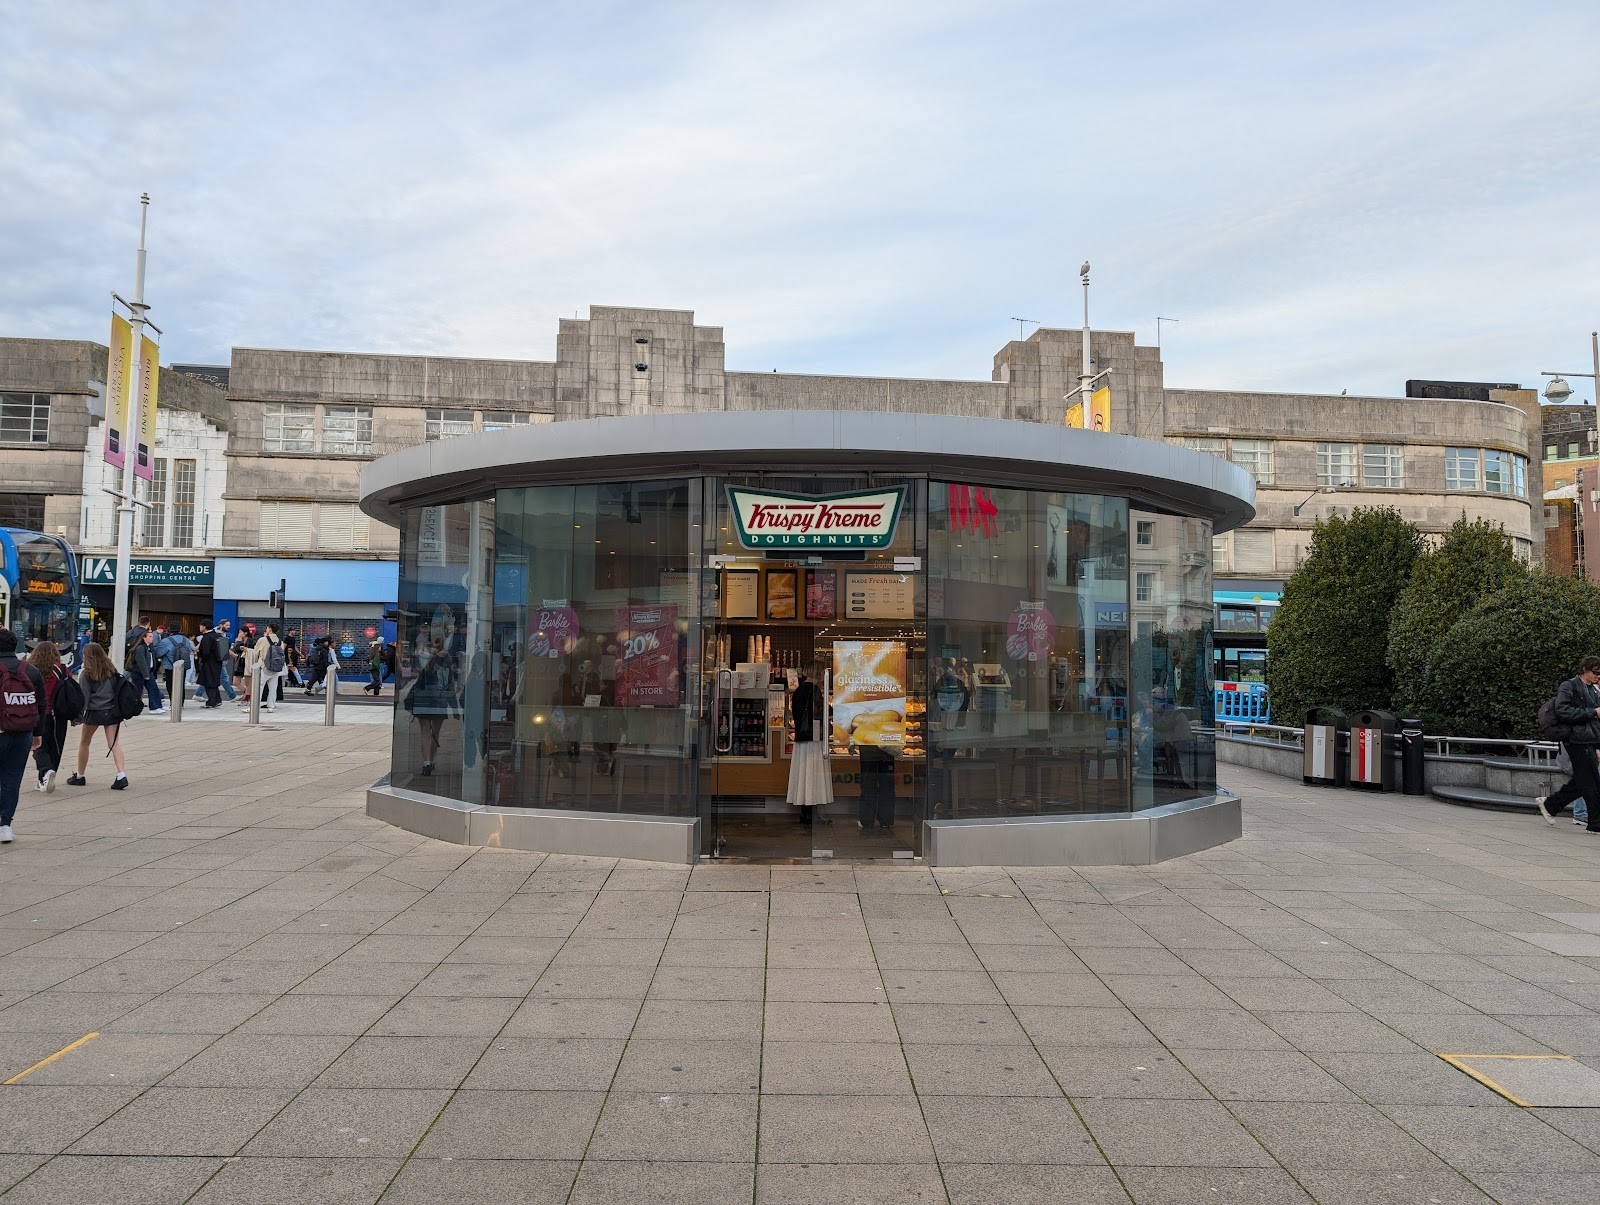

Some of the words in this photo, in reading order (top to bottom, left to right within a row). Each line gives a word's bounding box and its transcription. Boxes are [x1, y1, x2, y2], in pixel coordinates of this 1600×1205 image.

[144, 357, 152, 390] RIVER
[141, 393, 149, 435] ISLAND
[747, 503, 818, 533] Krispy
[814, 503, 885, 529] Kreme
[751, 535, 879, 544] DOUGHNUTS
[129, 564, 166, 574] PERIAL
[169, 565, 210, 575] ARCADE
[49, 581, 64, 594] 700
[539, 611, 571, 630] Barbie
[1017, 613, 1048, 632] Barbie
[623, 630, 660, 660] 20%
[838, 674, 888, 686] glaziness
[3, 690, 37, 706] VANS
[631, 687, 640, 695] IN
[640, 687, 664, 695] STORE
[832, 773, 861, 783] ADE
